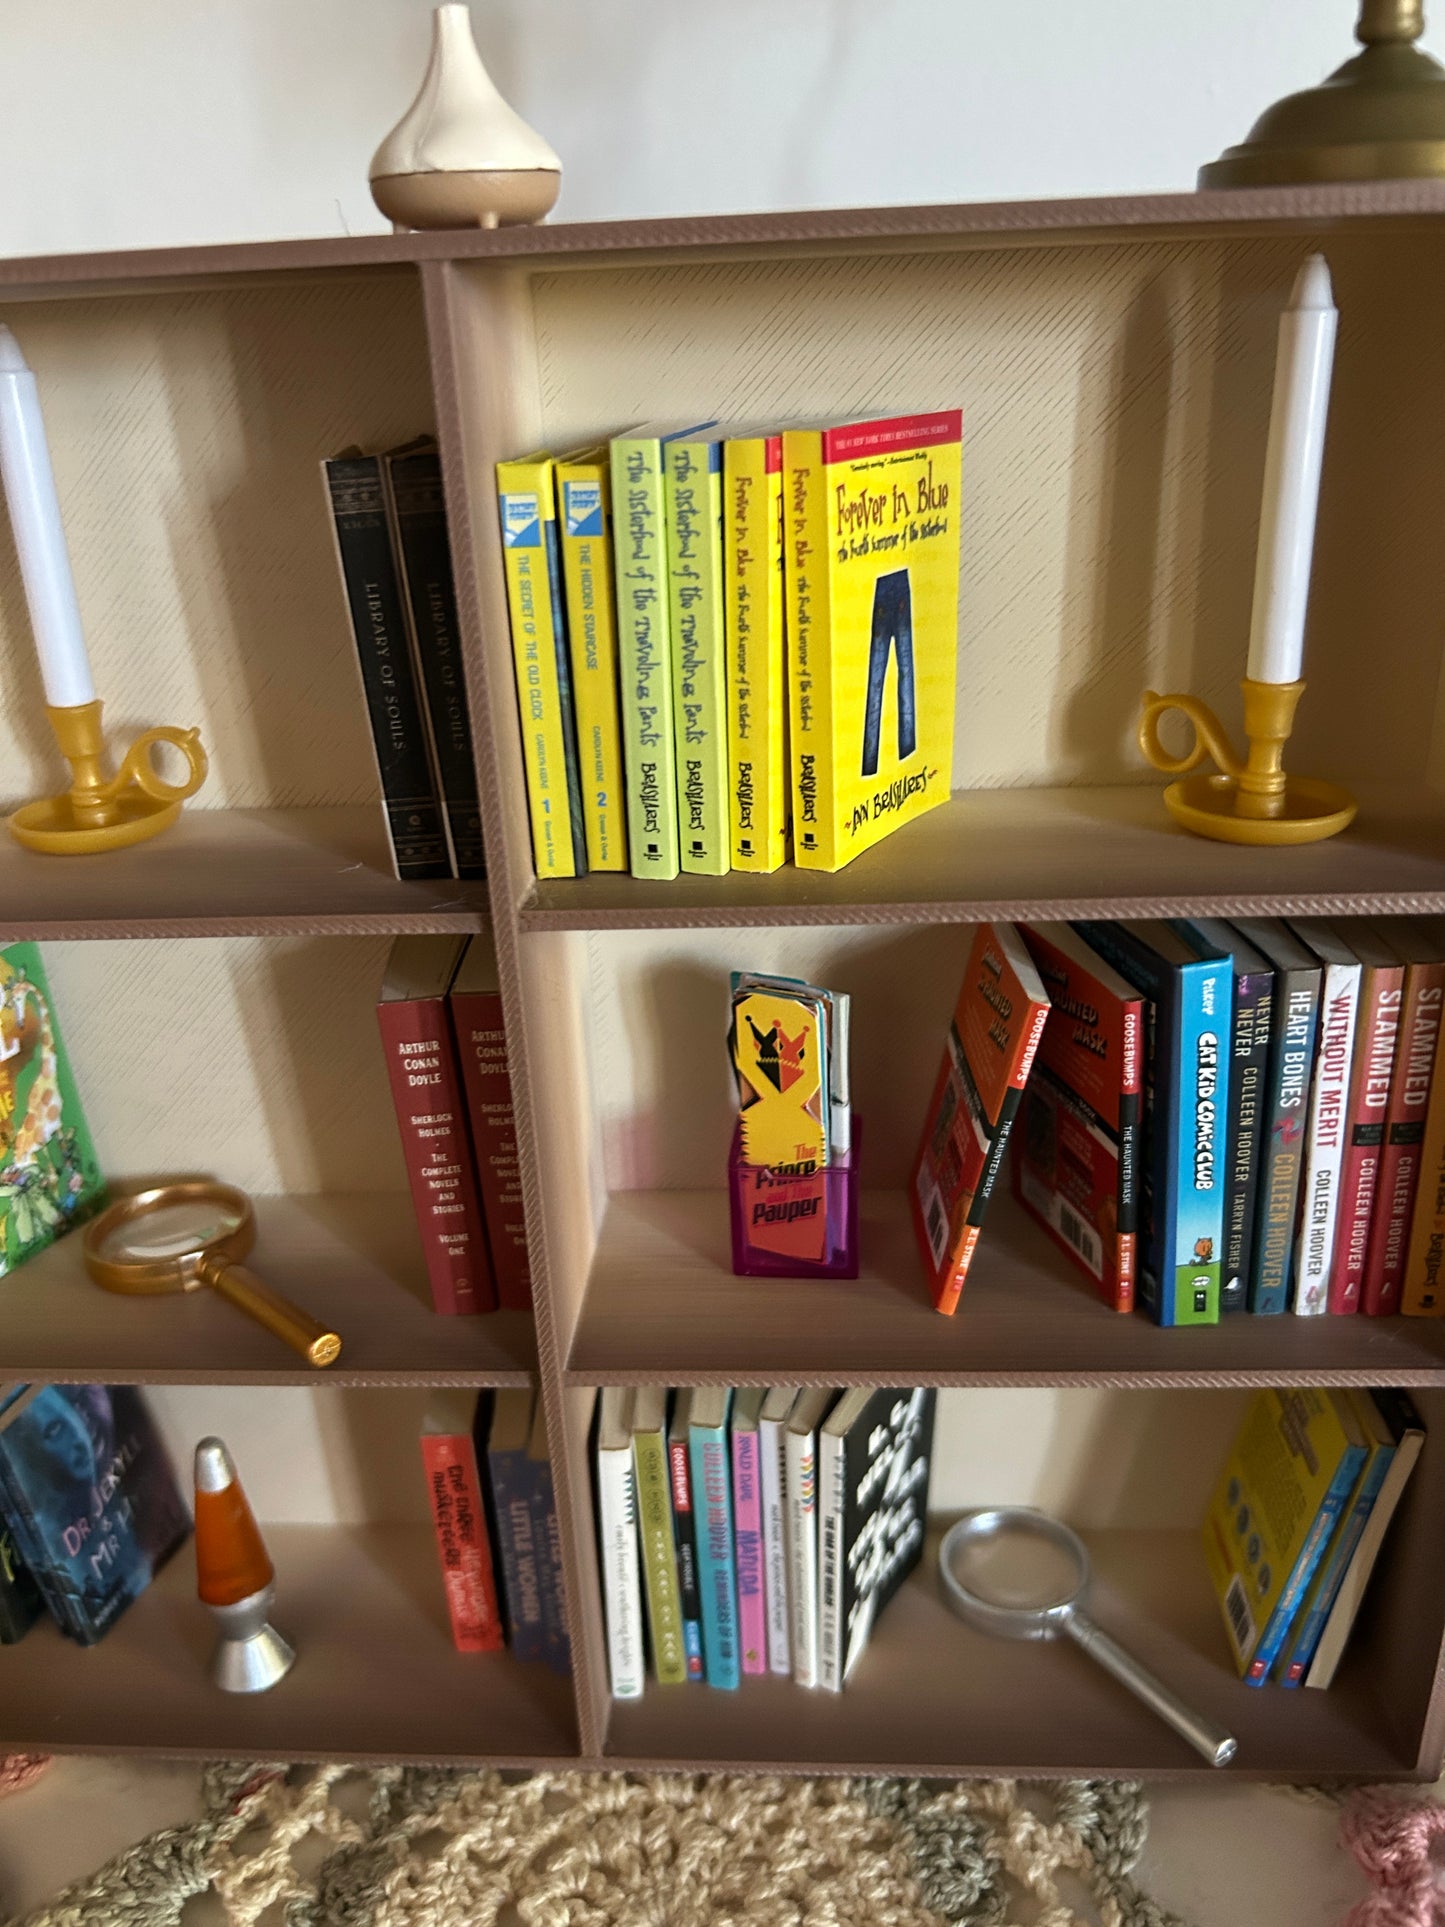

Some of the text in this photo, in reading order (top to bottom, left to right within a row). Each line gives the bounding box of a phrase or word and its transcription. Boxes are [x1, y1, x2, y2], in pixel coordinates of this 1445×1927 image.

[895, 427, 930, 440] BESTSELLING
[931, 424, 949, 434] SERIES
[627, 452, 652, 483] The
[674, 450, 698, 483] The
[836, 483, 887, 537] Forever
[917, 460, 949, 514] Blue
[628, 490, 654, 560] Sisterhood
[675, 489, 700, 559] Sisterhood
[624, 566, 654, 581] of
[672, 564, 700, 580] of
[737, 548, 755, 577] Blue
[795, 540, 813, 568] Blue
[579, 544, 598, 670] THE HIDDEN STAIRCASE
[633, 588, 657, 611] the
[679, 587, 703, 609] the
[518, 555, 543, 720] THE SECRET OF THE OLD CLOCK
[365, 583, 406, 751] LIBRARY OF SOULS
[427, 583, 465, 750] LIBRARY OF SOULS
[638, 706, 662, 747] Pants
[683, 703, 708, 744] Pants
[543, 799, 551, 813] 1
[597, 792, 607, 807] 2
[471, 1031, 506, 1042] ARTHU
[1235, 1008, 1255, 1057] NEVER
[1254, 995, 1272, 1046] NEVER
[398, 1041, 441, 1055] ARTHUR
[404, 1057, 440, 1071] CONAN
[1016, 1009, 1048, 1082] GOOSEBUMPS
[1122, 1013, 1137, 1087] GOOSEBUMPS
[1198, 1031, 1218, 1065] CAT
[1280, 990, 1312, 1108] HEART BONES
[1365, 989, 1402, 1108] SLAMMED
[1403, 987, 1442, 1106] SLAMMED
[409, 1073, 442, 1087] DOYLE
[1316, 995, 1351, 1148] WITHOUT MERIT
[411, 1113, 453, 1125] SHERLOCK
[418, 1127, 451, 1138] HOLMES
[1235, 1067, 1258, 1182] COLLEEN HOOVER
[421, 1165, 463, 1177] COMPLETE
[431, 1153, 448, 1163] THE
[793, 1142, 818, 1161] The
[979, 1118, 1013, 1199] THE HAUNTED MASK
[1120, 1125, 1133, 1204] THE HAUNTED MASK
[1194, 1150, 1214, 1191] CLUB
[429, 1179, 460, 1190] NOVELS
[755, 1157, 816, 1190] Prince
[1355, 1158, 1376, 1216] COLLEEN
[1393, 1156, 1413, 1214] COLLEEN
[432, 1203, 465, 1215] STORIES
[439, 1192, 456, 1202] AND
[752, 1195, 823, 1226] Pauper
[438, 1233, 470, 1244] VOLUME
[1228, 1192, 1246, 1269] TARRYN FISHER
[1261, 1153, 1295, 1289] COLLEEN HOOVER
[1307, 1169, 1332, 1277] COLLEEN HOOVER
[449, 1246, 466, 1256] ONE
[957, 1243, 974, 1269] STINE
[1119, 1250, 1129, 1274] STINE
[1347, 1221, 1367, 1270] HOOVER
[1384, 1219, 1404, 1269] HOOVER
[673, 1447, 689, 1505] GOOSEBUMPS
[738, 1436, 753, 1501] ROALD DAHL
[703, 1443, 728, 1561] COLLEEN HOOVER
[510, 1501, 541, 1623] LITTLE WOMEN
[737, 1530, 759, 1596] MATILDA
[715, 1569, 733, 1659] REMINDERS OF HIM
